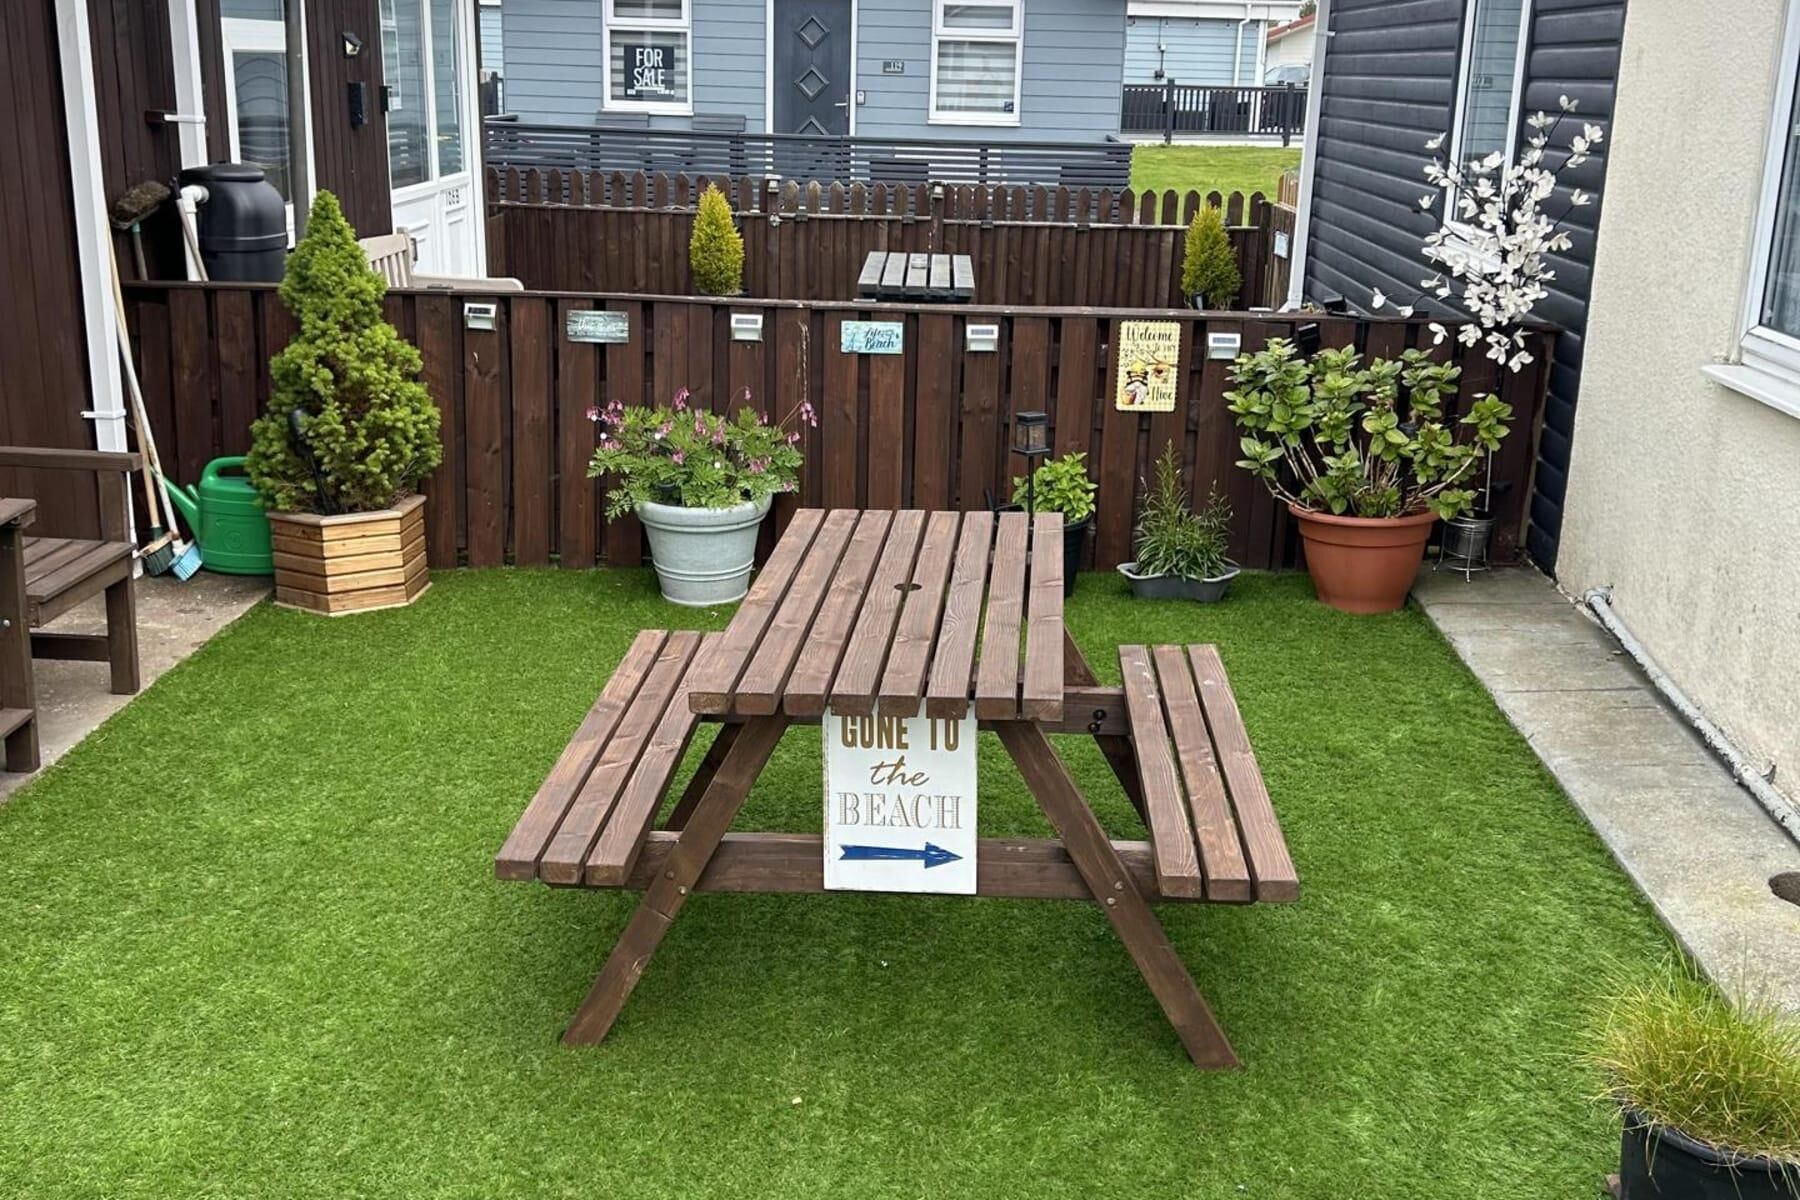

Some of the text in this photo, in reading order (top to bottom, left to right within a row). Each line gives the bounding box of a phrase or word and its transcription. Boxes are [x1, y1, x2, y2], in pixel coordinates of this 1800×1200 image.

[636, 48, 663, 67] FOR
[633, 67, 665, 87] SALE
[1126, 326, 1173, 342] Welcome
[841, 715, 959, 751] GONE TO
[870, 755, 930, 787] the
[837, 792, 963, 829] BEACH
